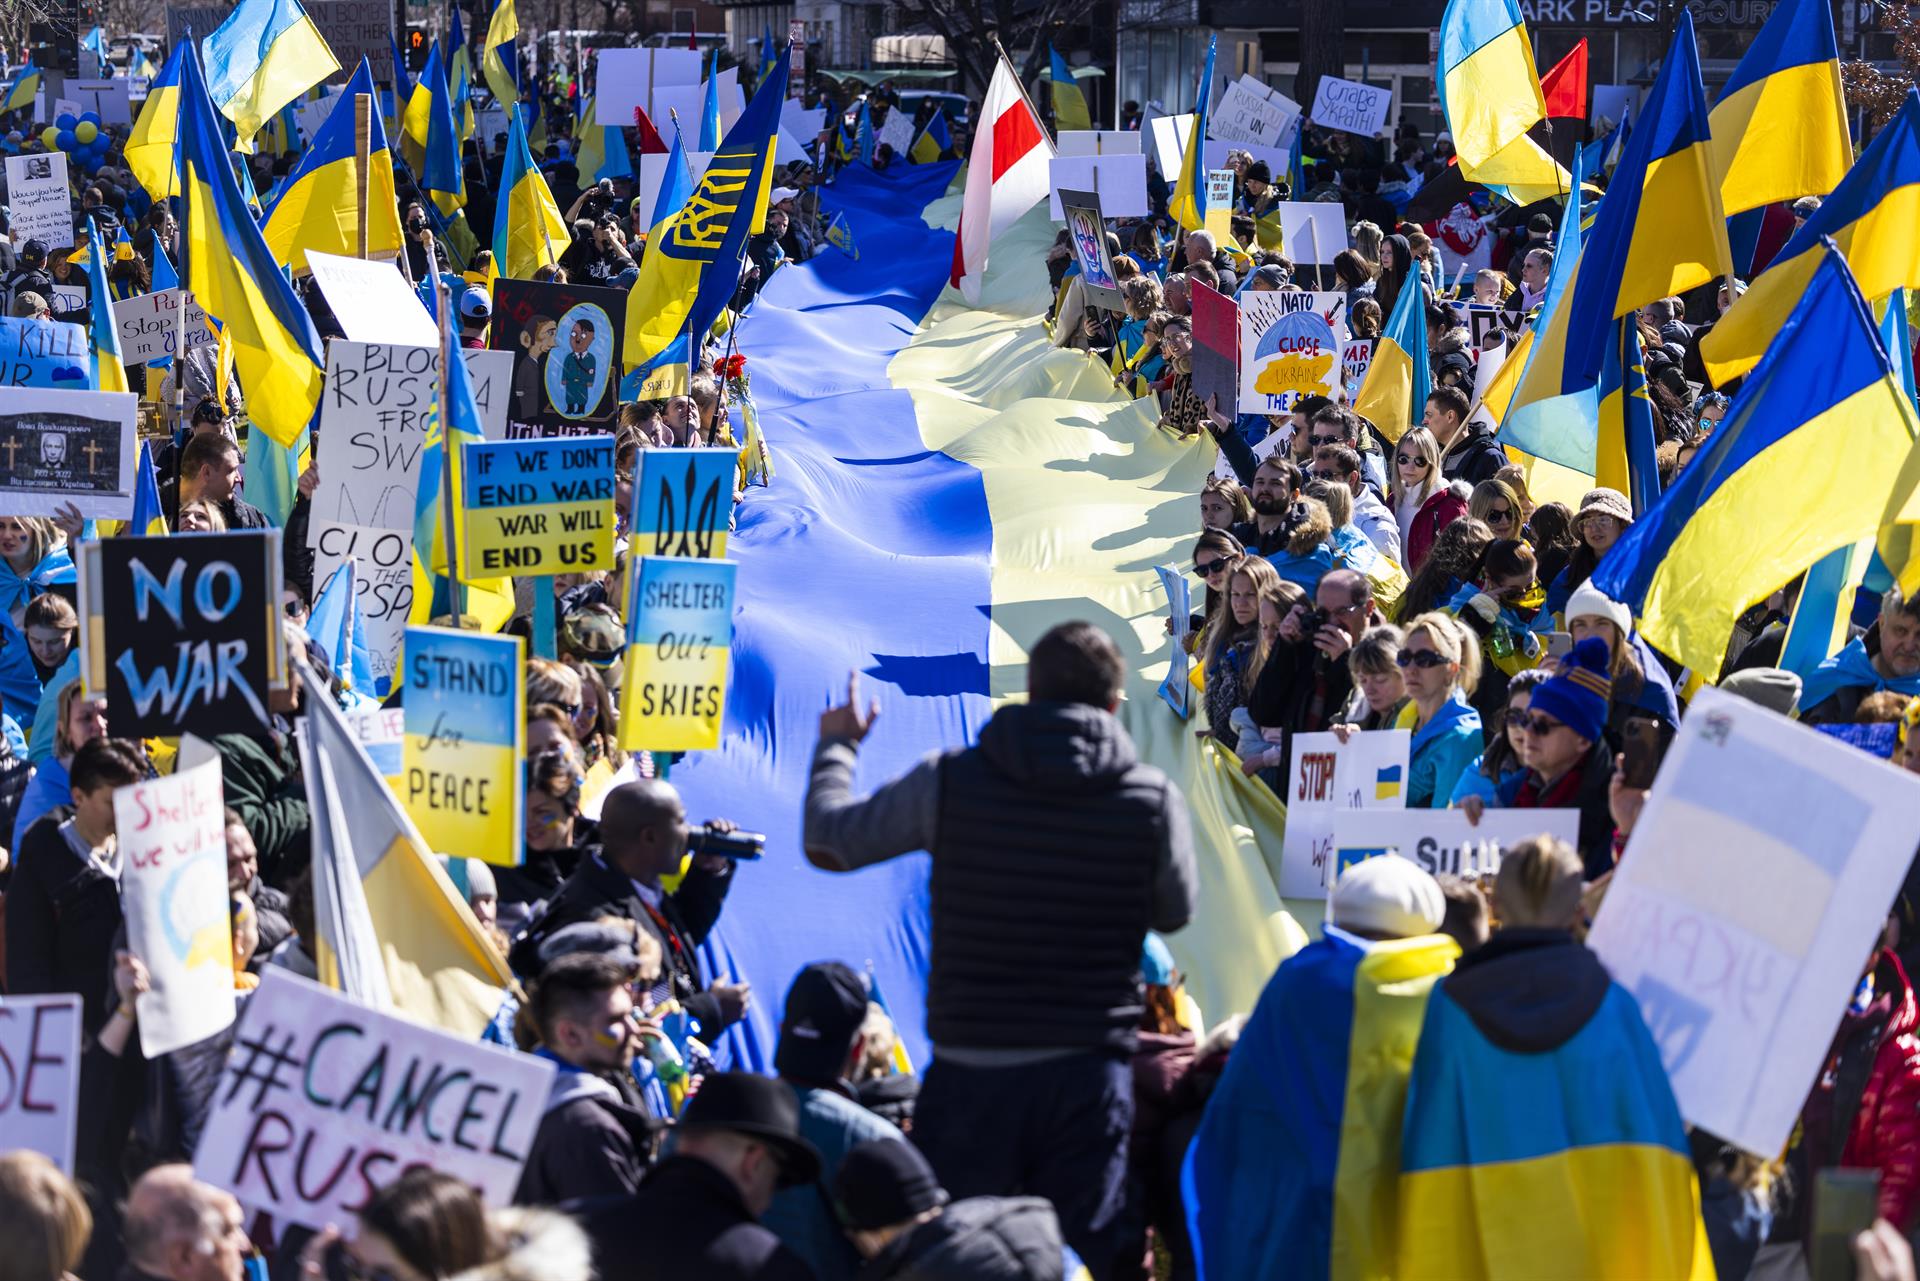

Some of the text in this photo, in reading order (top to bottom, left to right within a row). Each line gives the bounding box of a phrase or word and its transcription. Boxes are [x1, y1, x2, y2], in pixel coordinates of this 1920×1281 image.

[336, 2, 389, 22] BOMBS
[1521, 0, 1777, 24] ARK PLAC GOUR
[325, 24, 352, 43] OSE
[1233, 88, 1264, 114] RUSSIA
[1327, 81, 1377, 112] Слава
[1234, 109, 1265, 135] OF UN
[1281, 293, 1314, 315] NATO
[18, 324, 81, 359] KILL
[123, 317, 171, 339] Stop
[137, 343, 153, 354] in
[1279, 336, 1320, 356] CLOSE
[331, 362, 491, 414] RUSA
[1275, 365, 1320, 384] UKRAINE
[1266, 393, 1288, 411] THE
[55, 470, 72, 479] 2022
[478, 447, 612, 475] IF WE DON'T
[479, 477, 612, 507] END WAR
[497, 510, 603, 537] WAR WILL
[482, 542, 598, 569] END US
[375, 568, 409, 584] THE
[128, 556, 243, 631] NO
[644, 581, 725, 610] SHELTER
[115, 639, 272, 730] WAR
[413, 653, 509, 698] STAND
[642, 683, 720, 717] SKIES
[417, 710, 464, 752] for
[1298, 752, 1337, 802] STOP!
[410, 767, 491, 816] PEACE
[1347, 787, 1363, 809] in
[223, 1022, 523, 1162] #CANCEL
